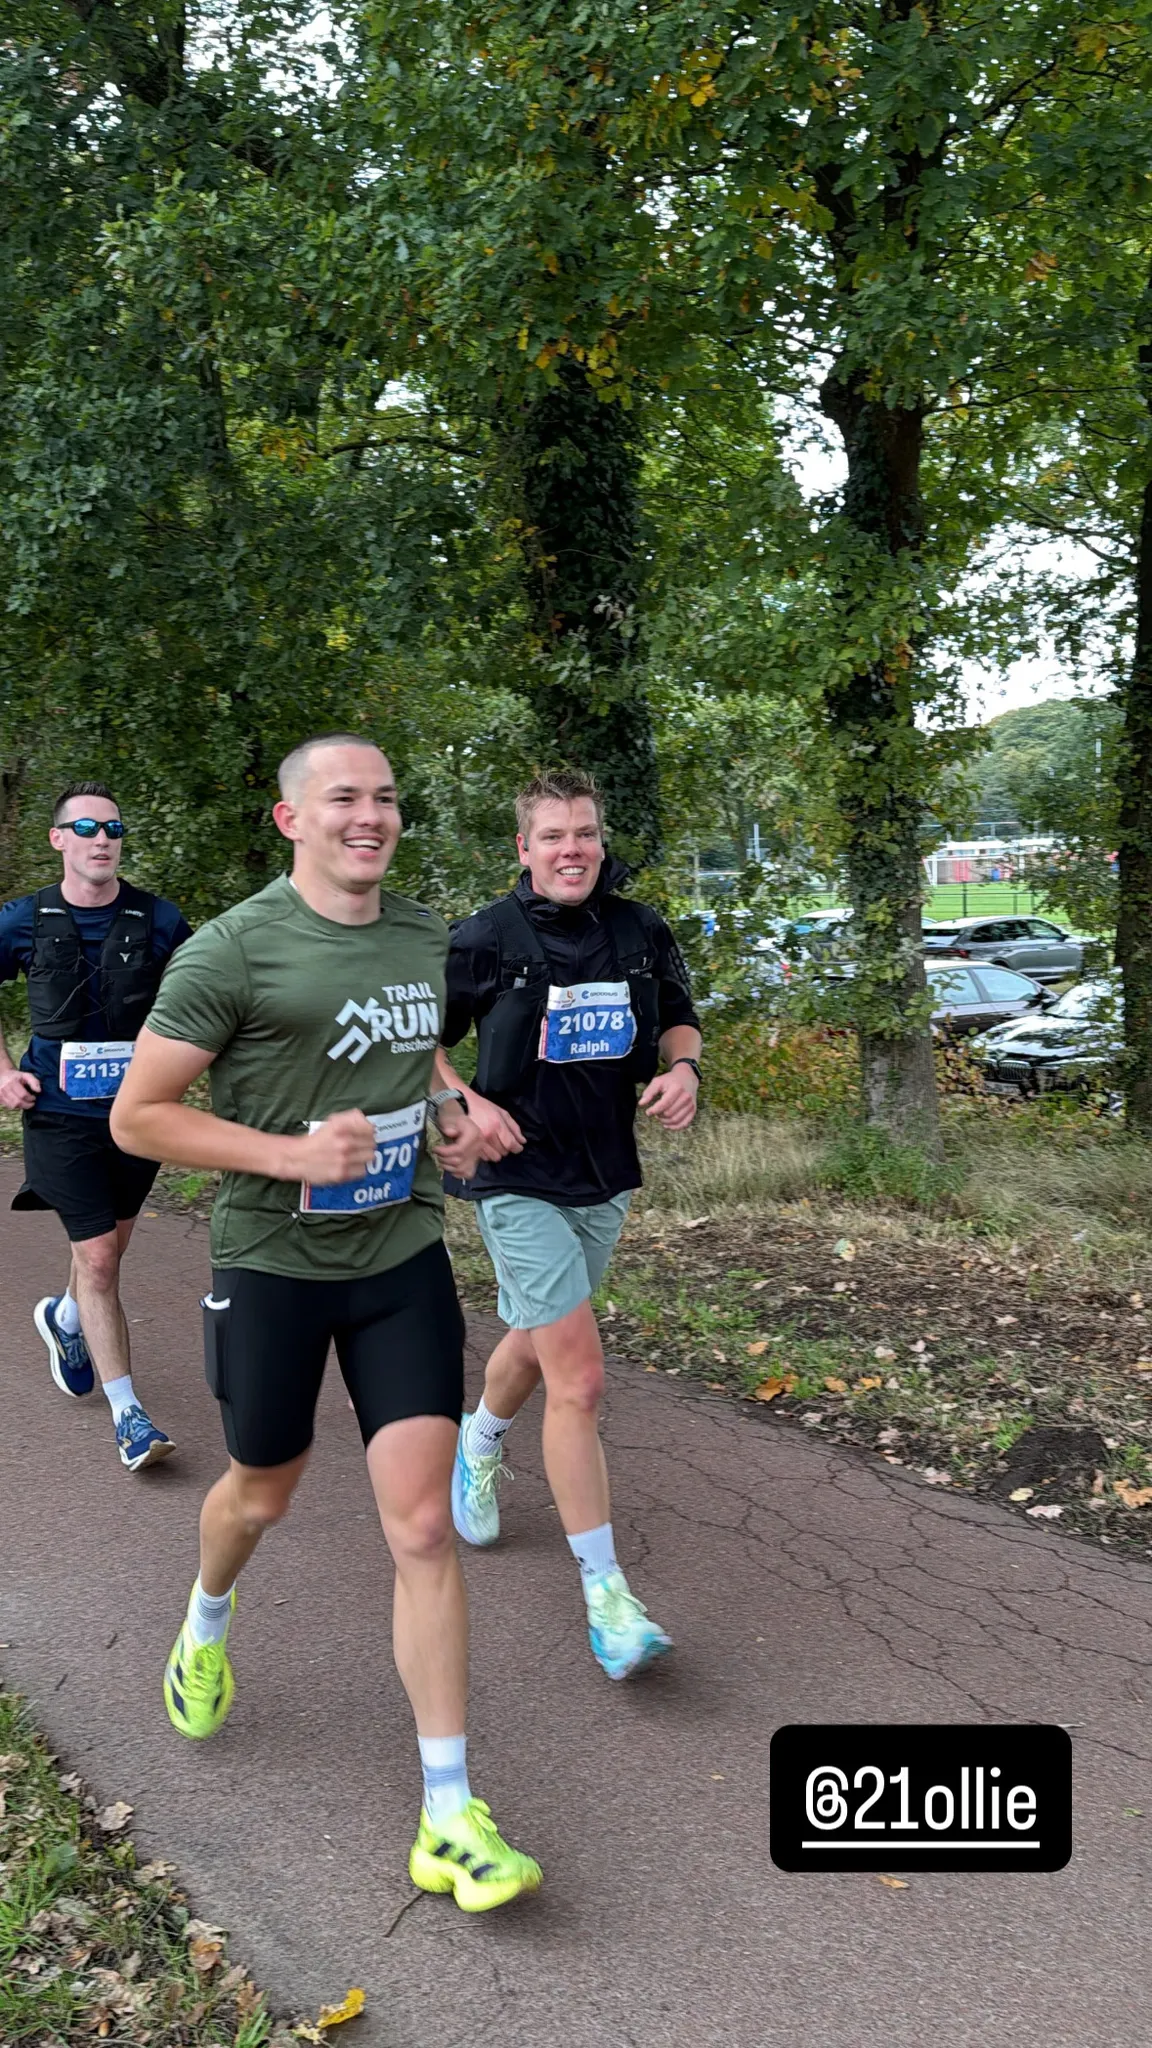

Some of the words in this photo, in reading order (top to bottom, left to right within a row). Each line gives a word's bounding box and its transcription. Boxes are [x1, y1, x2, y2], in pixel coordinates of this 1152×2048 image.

[381, 981, 437, 1003] TRAIL
[370, 1002, 439, 1043] RUN
[558, 1010, 625, 1035] 21078
[570, 1039, 610, 1056] Ralph
[353, 1181, 392, 1204] Olaf
